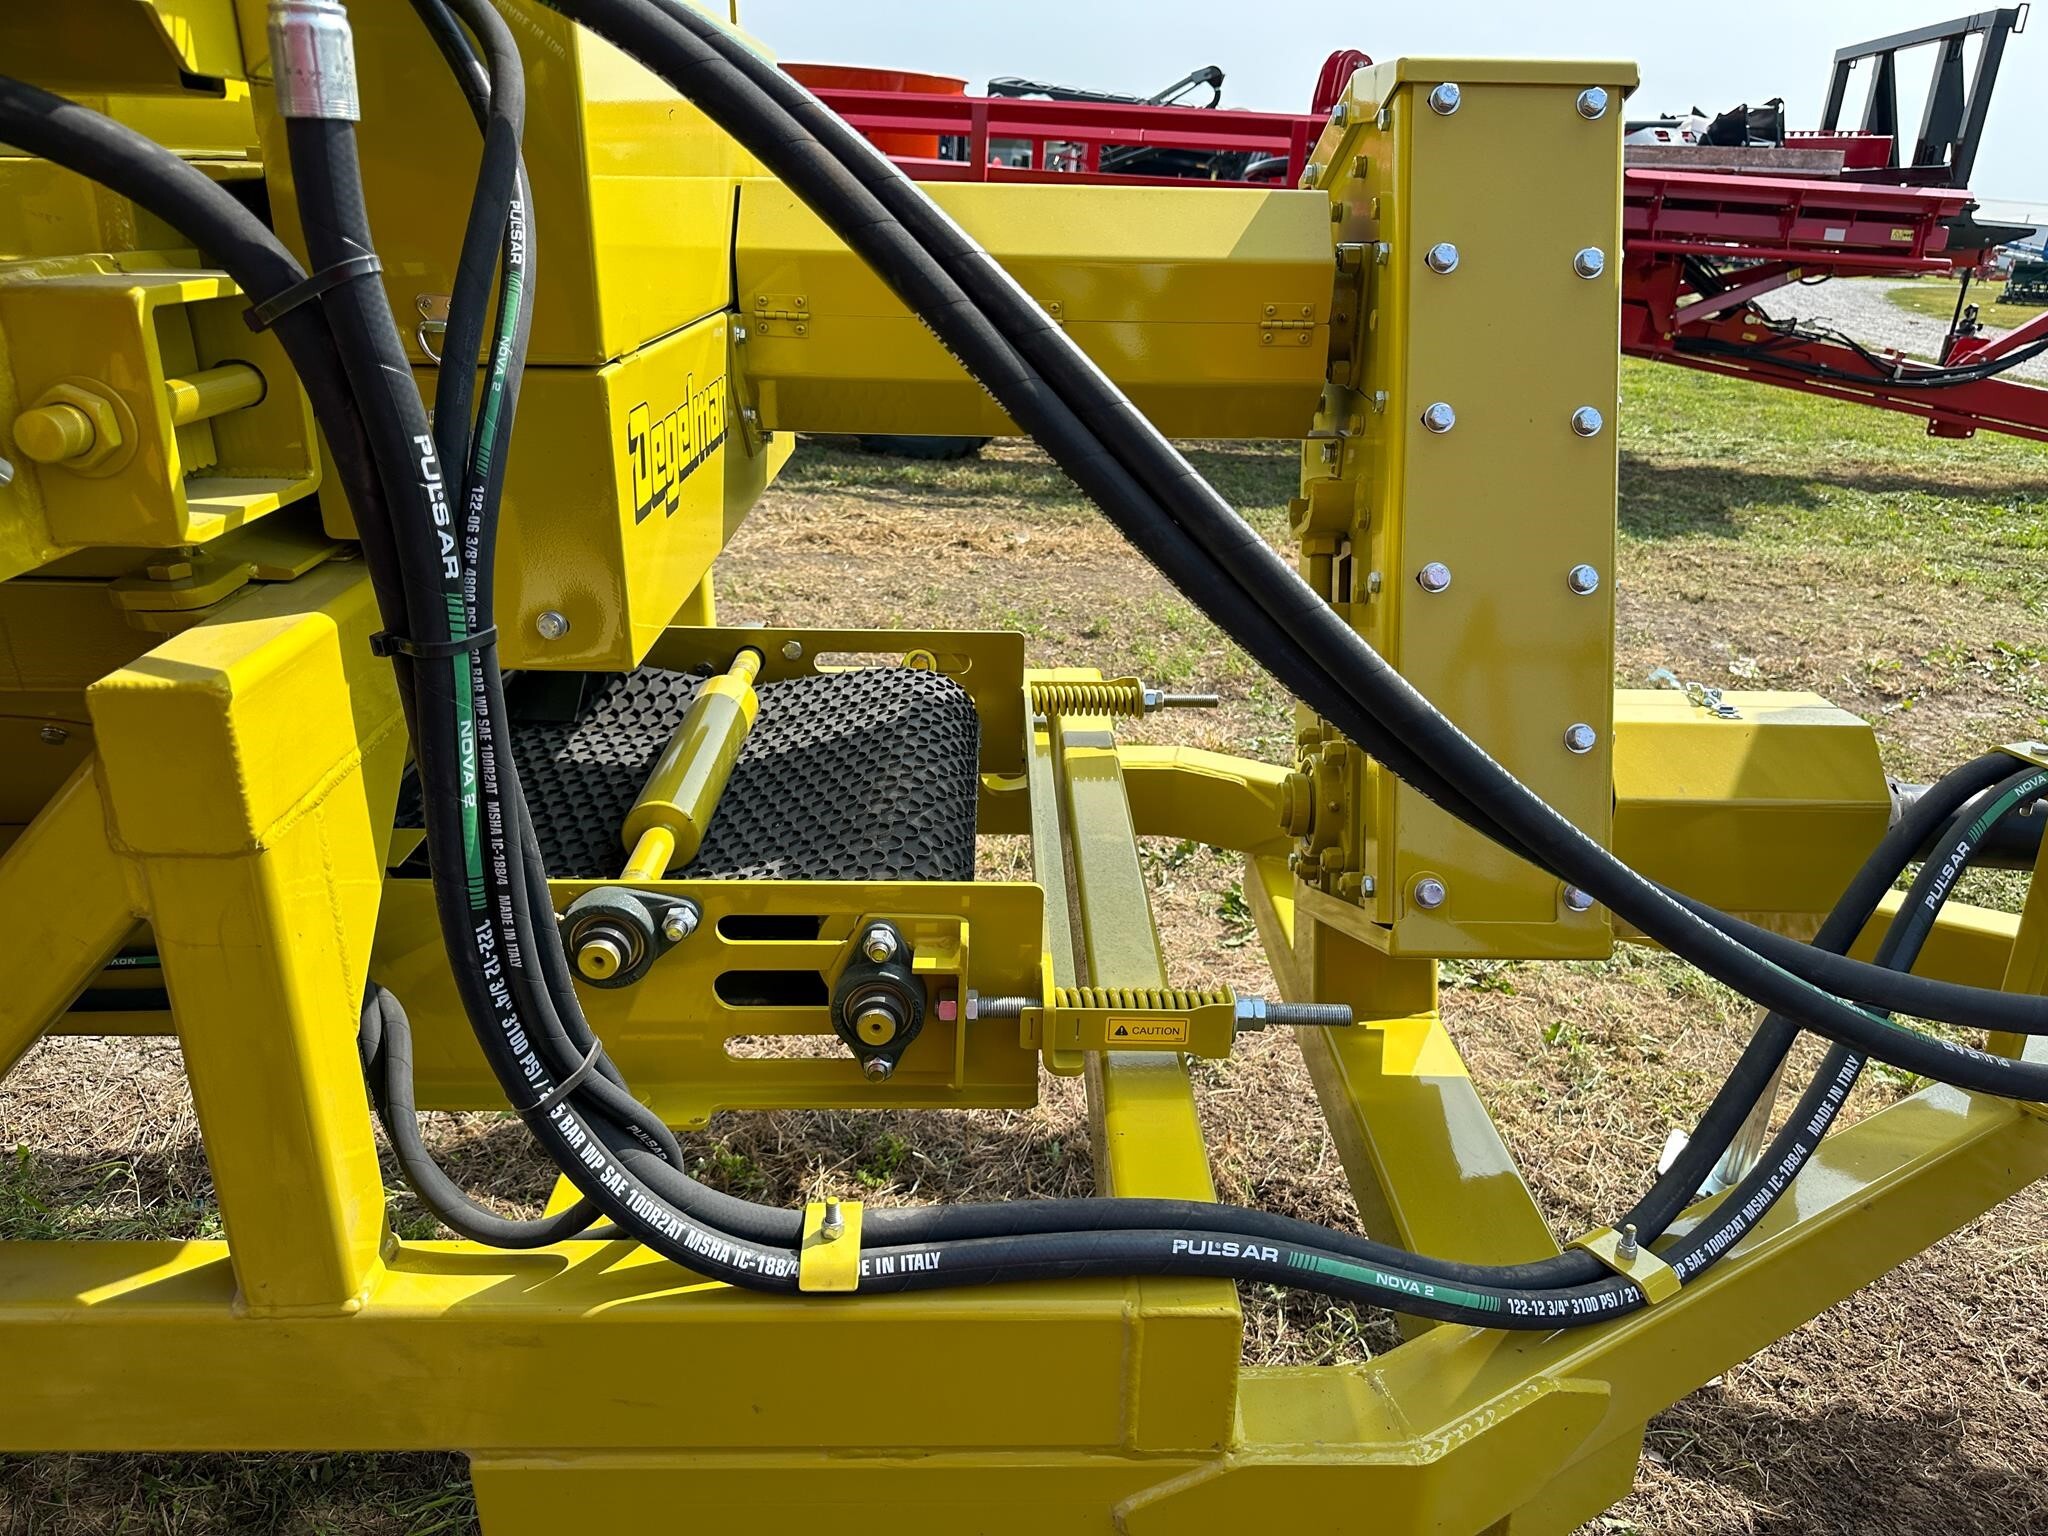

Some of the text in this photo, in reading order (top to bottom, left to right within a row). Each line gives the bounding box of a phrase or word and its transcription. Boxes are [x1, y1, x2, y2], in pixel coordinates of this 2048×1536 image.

[509, 199, 524, 265] PULSAR
[492, 335, 511, 376] NOVA
[491, 381, 502, 392] 2
[413, 434, 460, 580] PULSAR
[466, 485, 485, 533] 122-06
[477, 718, 492, 741] SAE
[460, 720, 476, 788] NOVA
[480, 744, 499, 796] 100R2AT
[2013, 774, 2047, 797] NOVA
[463, 793, 476, 809] 2
[486, 801, 502, 835] MSHA
[491, 838, 509, 886] IC-188/4
[1924, 840, 1971, 911] PULSAR
[498, 895, 514, 926] MADE
[474, 918, 501, 980] 122-12
[503, 928, 517, 942] IN
[506, 943, 523, 969] ITALY
[488, 977, 513, 1010] 3/4"
[500, 1011, 529, 1057] 3100
[1131, 1026, 1180, 1035] CAUTION
[518, 1052, 544, 1082] PSI
[1835, 1053, 1862, 1092] ITALY
[1826, 1084, 1846, 1106] IN
[557, 1113, 587, 1150] BAR
[1805, 1105, 1831, 1138] MADE
[579, 1141, 606, 1171] WP
[1767, 1141, 1808, 1194] IC-188/4
[599, 1163, 630, 1198] SAE
[625, 1187, 688, 1241] 100R2AT
[1741, 1186, 1774, 1224] MSHA
[683, 1228, 730, 1264] MSHA
[1171, 1238, 1280, 1263] PULSAR
[1703, 1214, 1748, 1257] 100R2AT
[875, 1256, 895, 1275] IN
[900, 1251, 942, 1272] ITALY
[1684, 1248, 1707, 1272] SAE
[1375, 1271, 1421, 1295] NOVA
[1424, 1284, 1435, 1297] 2
[1624, 1285, 1644, 1304] 21
[1507, 1297, 1546, 1317] 122-12
[1548, 1298, 1570, 1316] 3/4"
[1572, 1297, 1600, 1315] 3100
[1598, 1292, 1619, 1310] PSI
